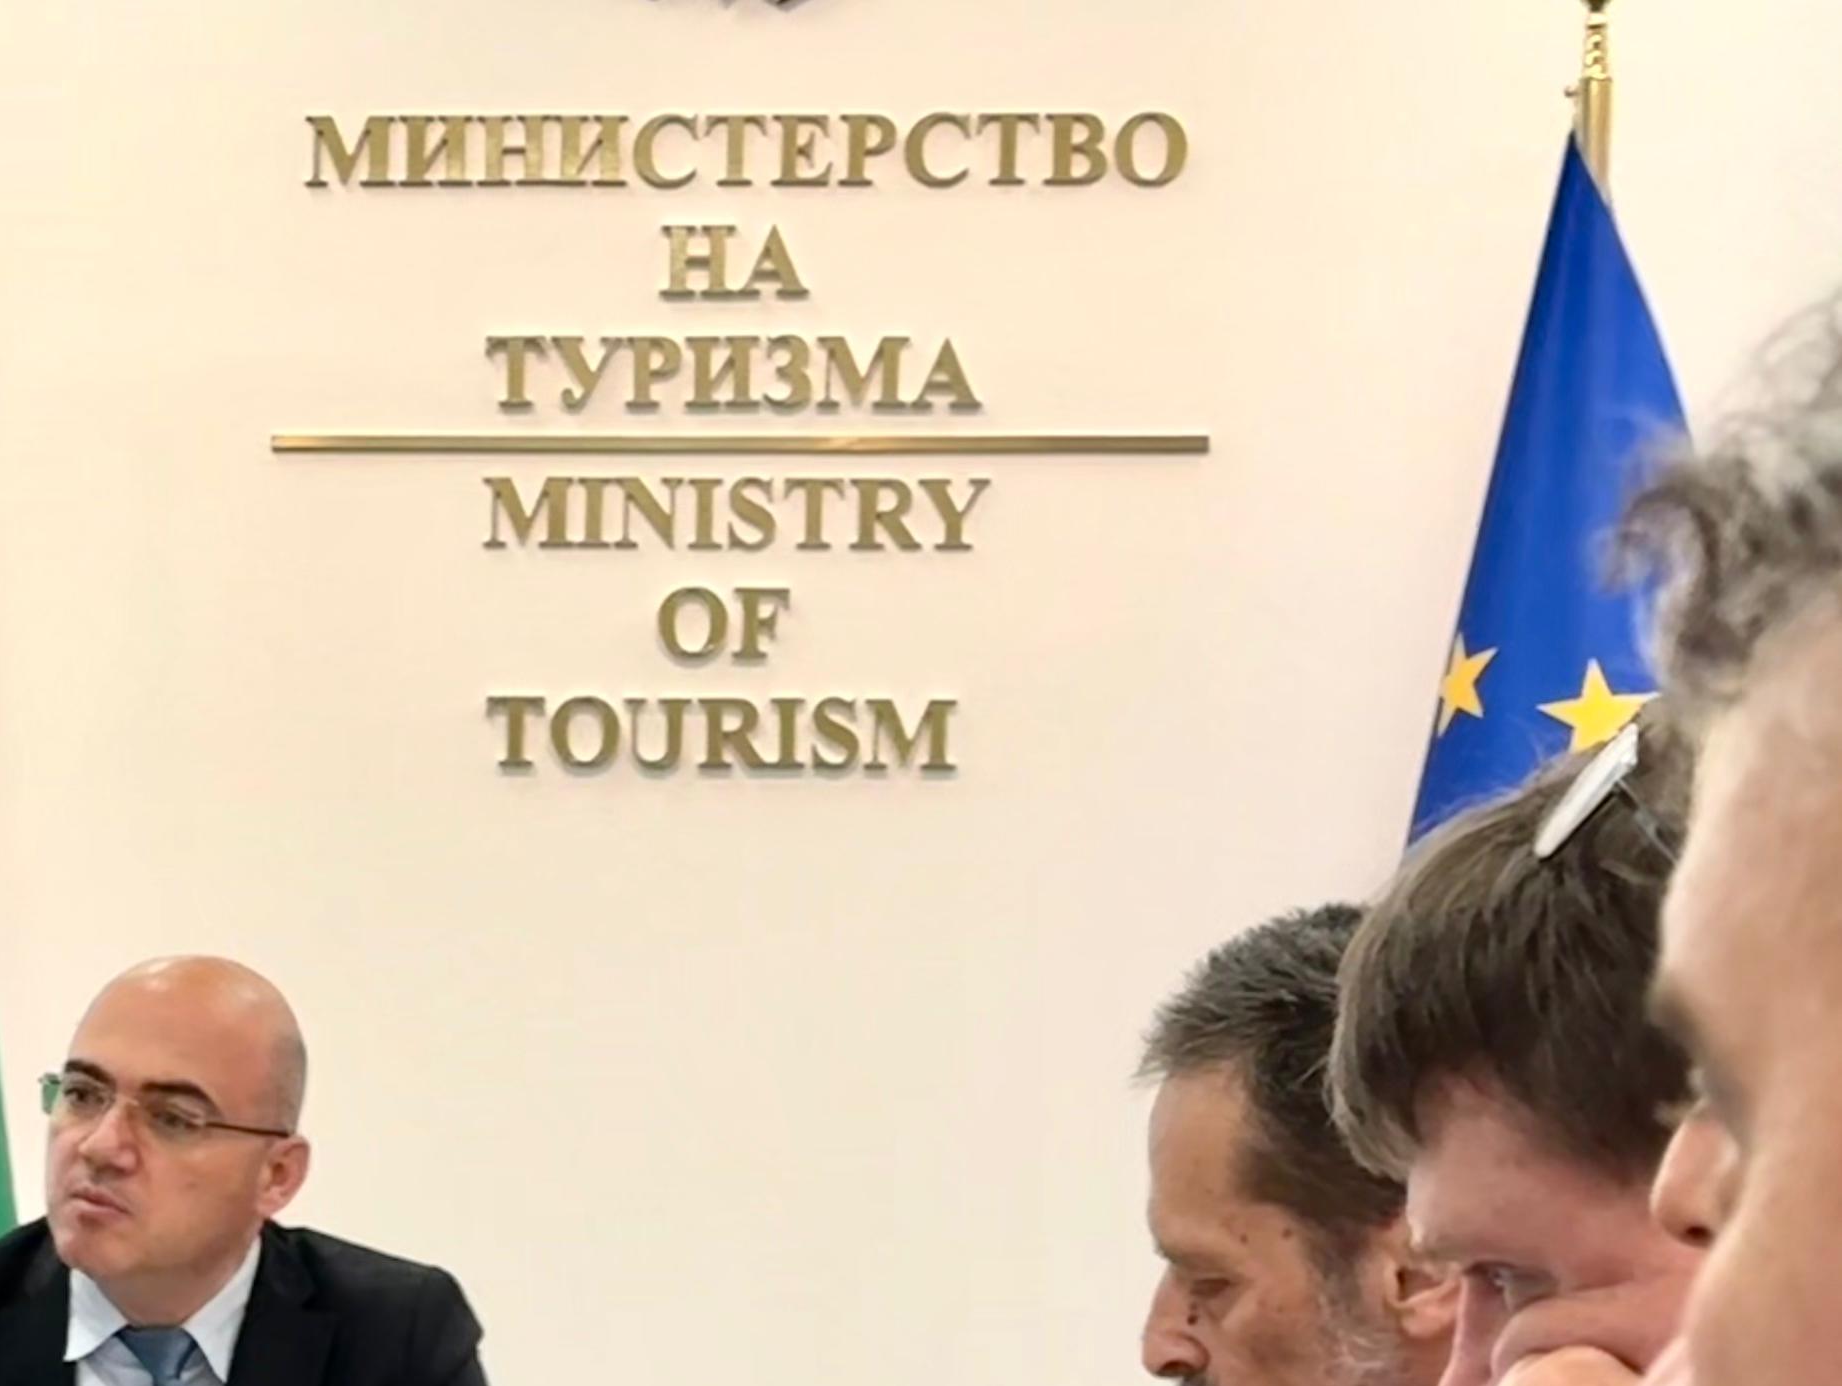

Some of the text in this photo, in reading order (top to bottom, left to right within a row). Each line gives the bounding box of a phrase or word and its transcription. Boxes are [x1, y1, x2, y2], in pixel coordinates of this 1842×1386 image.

[305, 112, 1189, 190] МИНИСТЕРСТВО
[659, 224, 809, 302] НА
[485, 334, 983, 415] ТУРИЗМА
[482, 476, 991, 552] MINISTRY
[657, 586, 791, 667] OF
[485, 695, 958, 779] TOURISM
